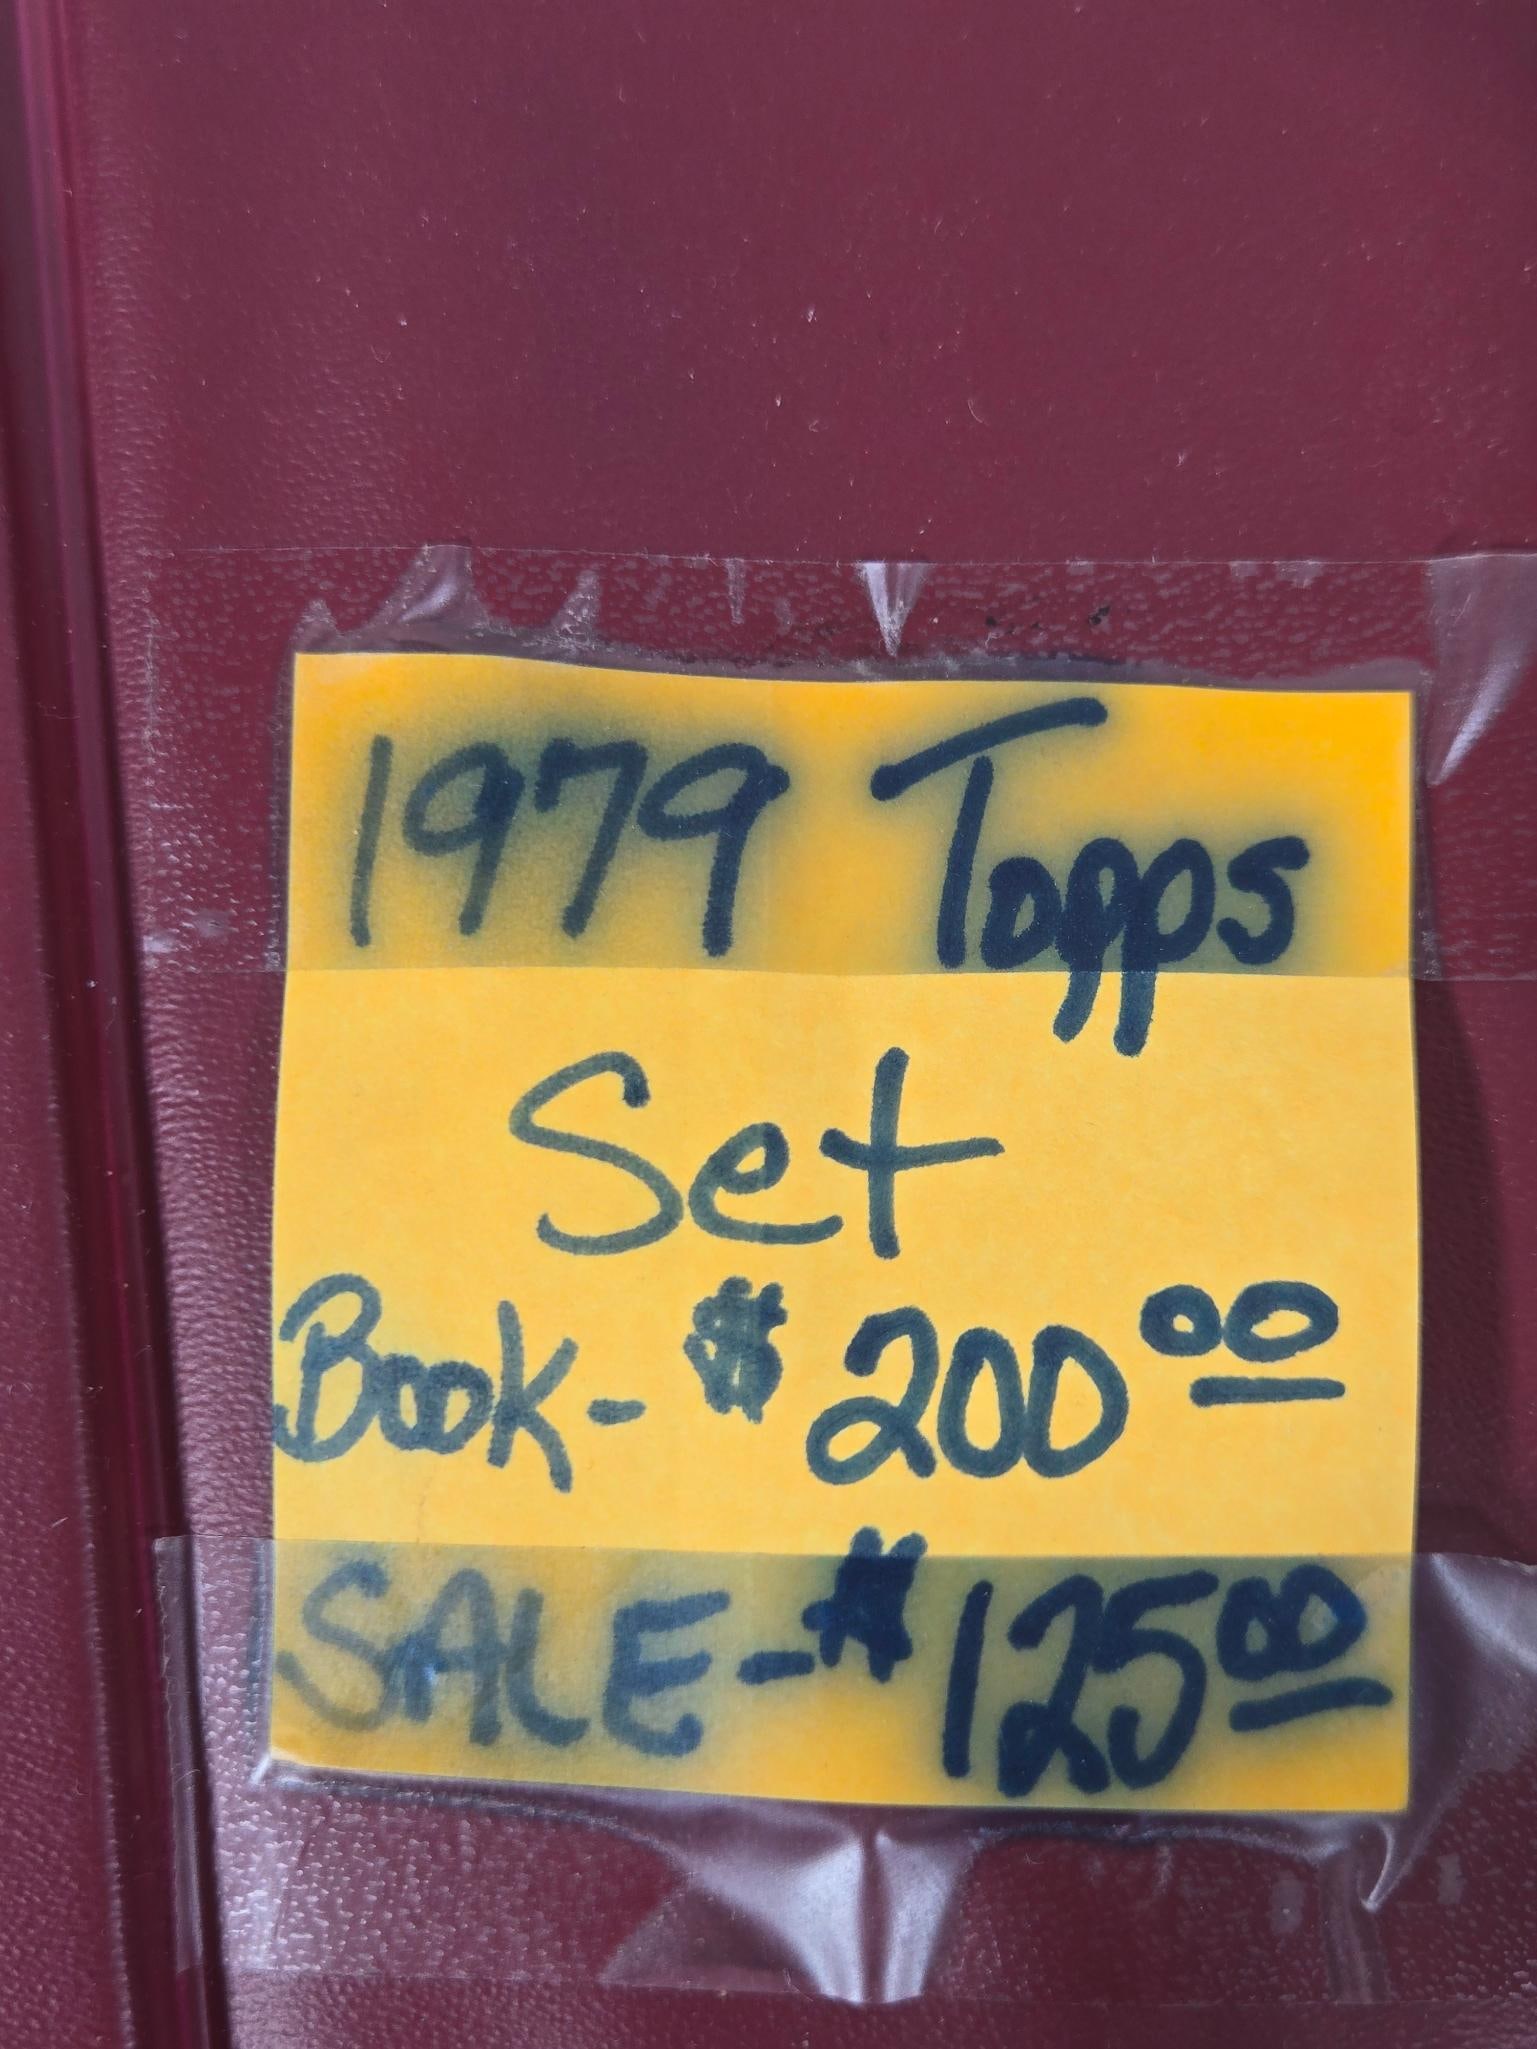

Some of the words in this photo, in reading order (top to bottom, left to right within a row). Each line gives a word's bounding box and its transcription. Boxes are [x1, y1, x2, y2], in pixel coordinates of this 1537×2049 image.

[350, 734, 790, 957] 1979
[870, 696, 1309, 1057] Topps
[508, 1046, 1005, 1260] Set
